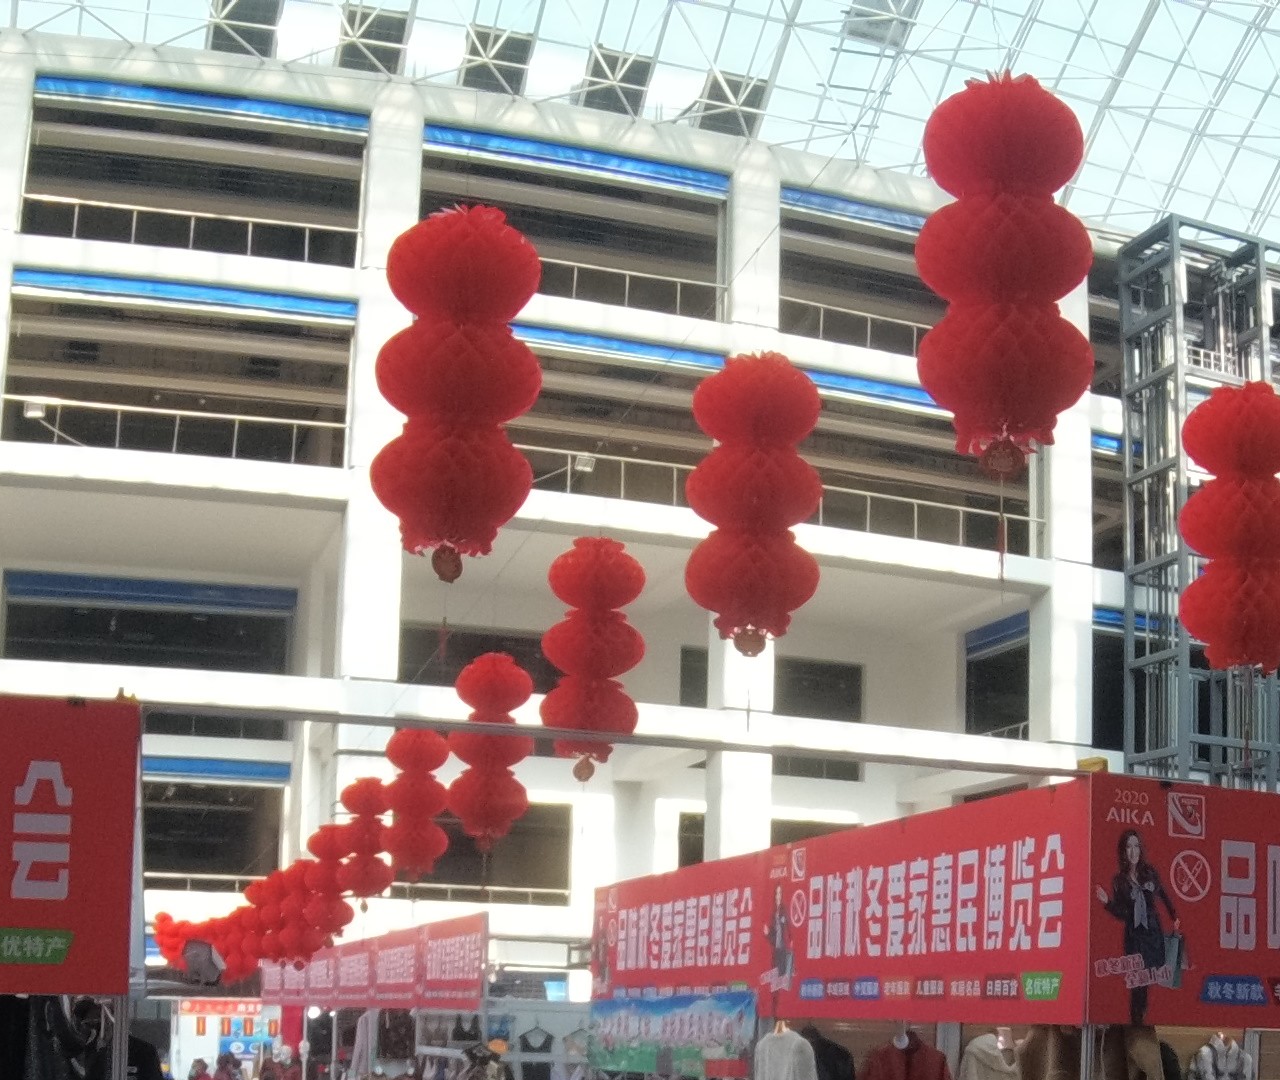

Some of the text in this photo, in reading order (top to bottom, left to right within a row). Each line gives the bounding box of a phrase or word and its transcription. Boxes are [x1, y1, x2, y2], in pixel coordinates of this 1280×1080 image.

[1113, 789, 1150, 806] 2020
[1105, 808, 1156, 828] AIKA
[806, 833, 1065, 959] 品味秋冬爱家惠民博览会
[1207, 982, 1265, 1001] 秋冬新款
